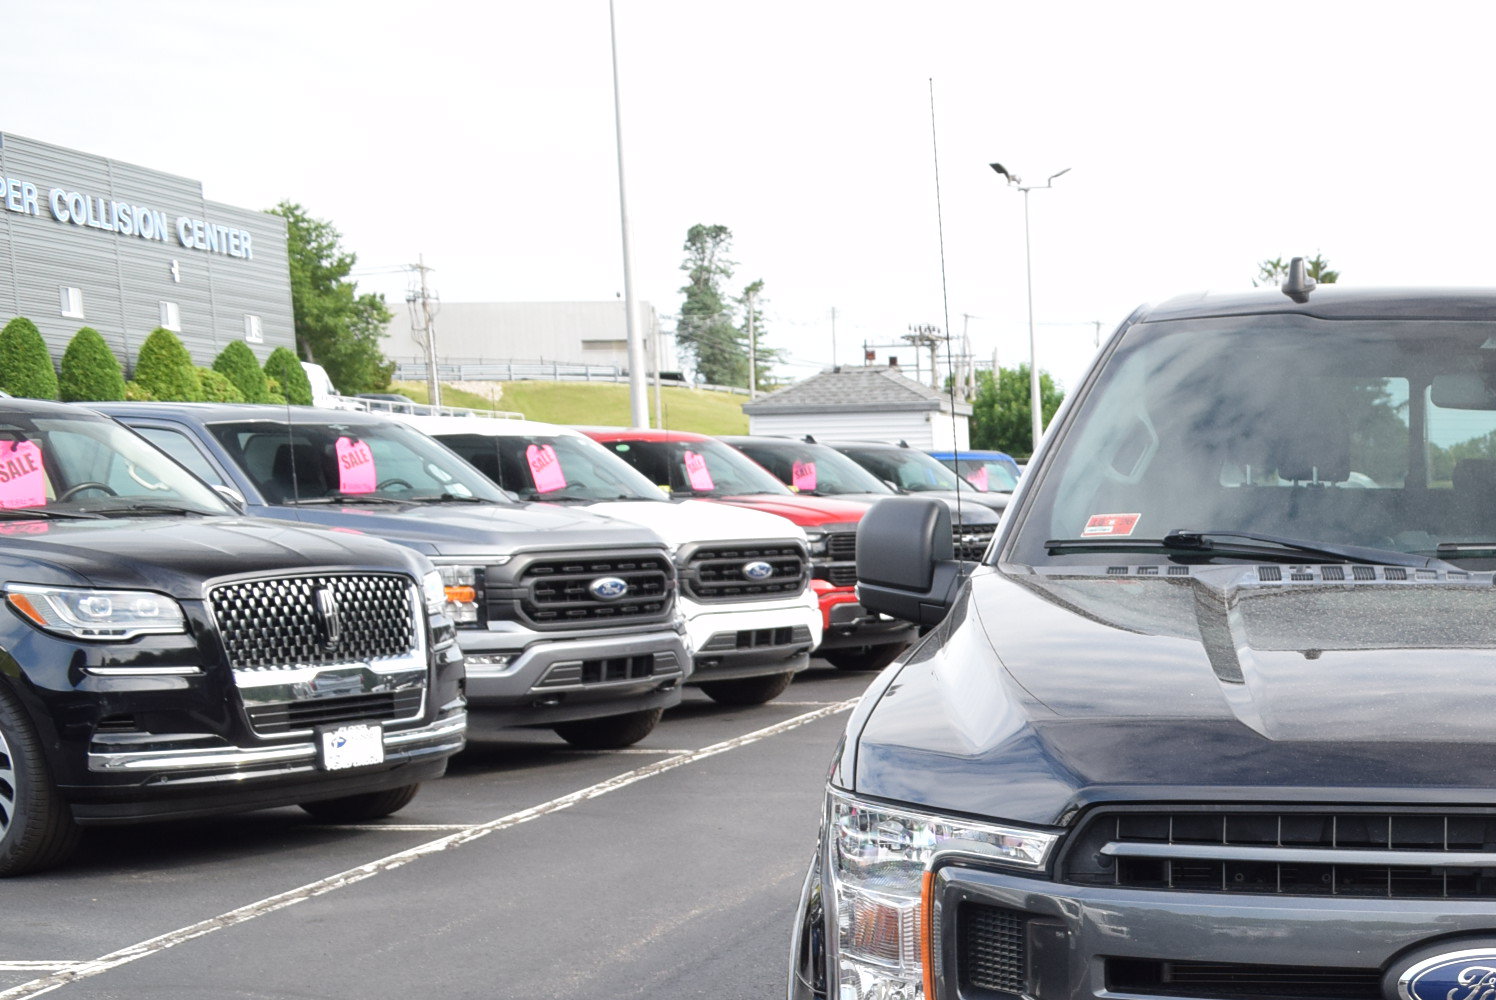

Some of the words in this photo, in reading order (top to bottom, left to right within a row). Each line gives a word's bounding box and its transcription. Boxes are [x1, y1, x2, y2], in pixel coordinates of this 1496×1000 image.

[48, 187, 169, 242] COLLISION
[175, 216, 253, 260] CENTER
[0, 453, 38, 483] SALE
[341, 448, 370, 470] SALE
